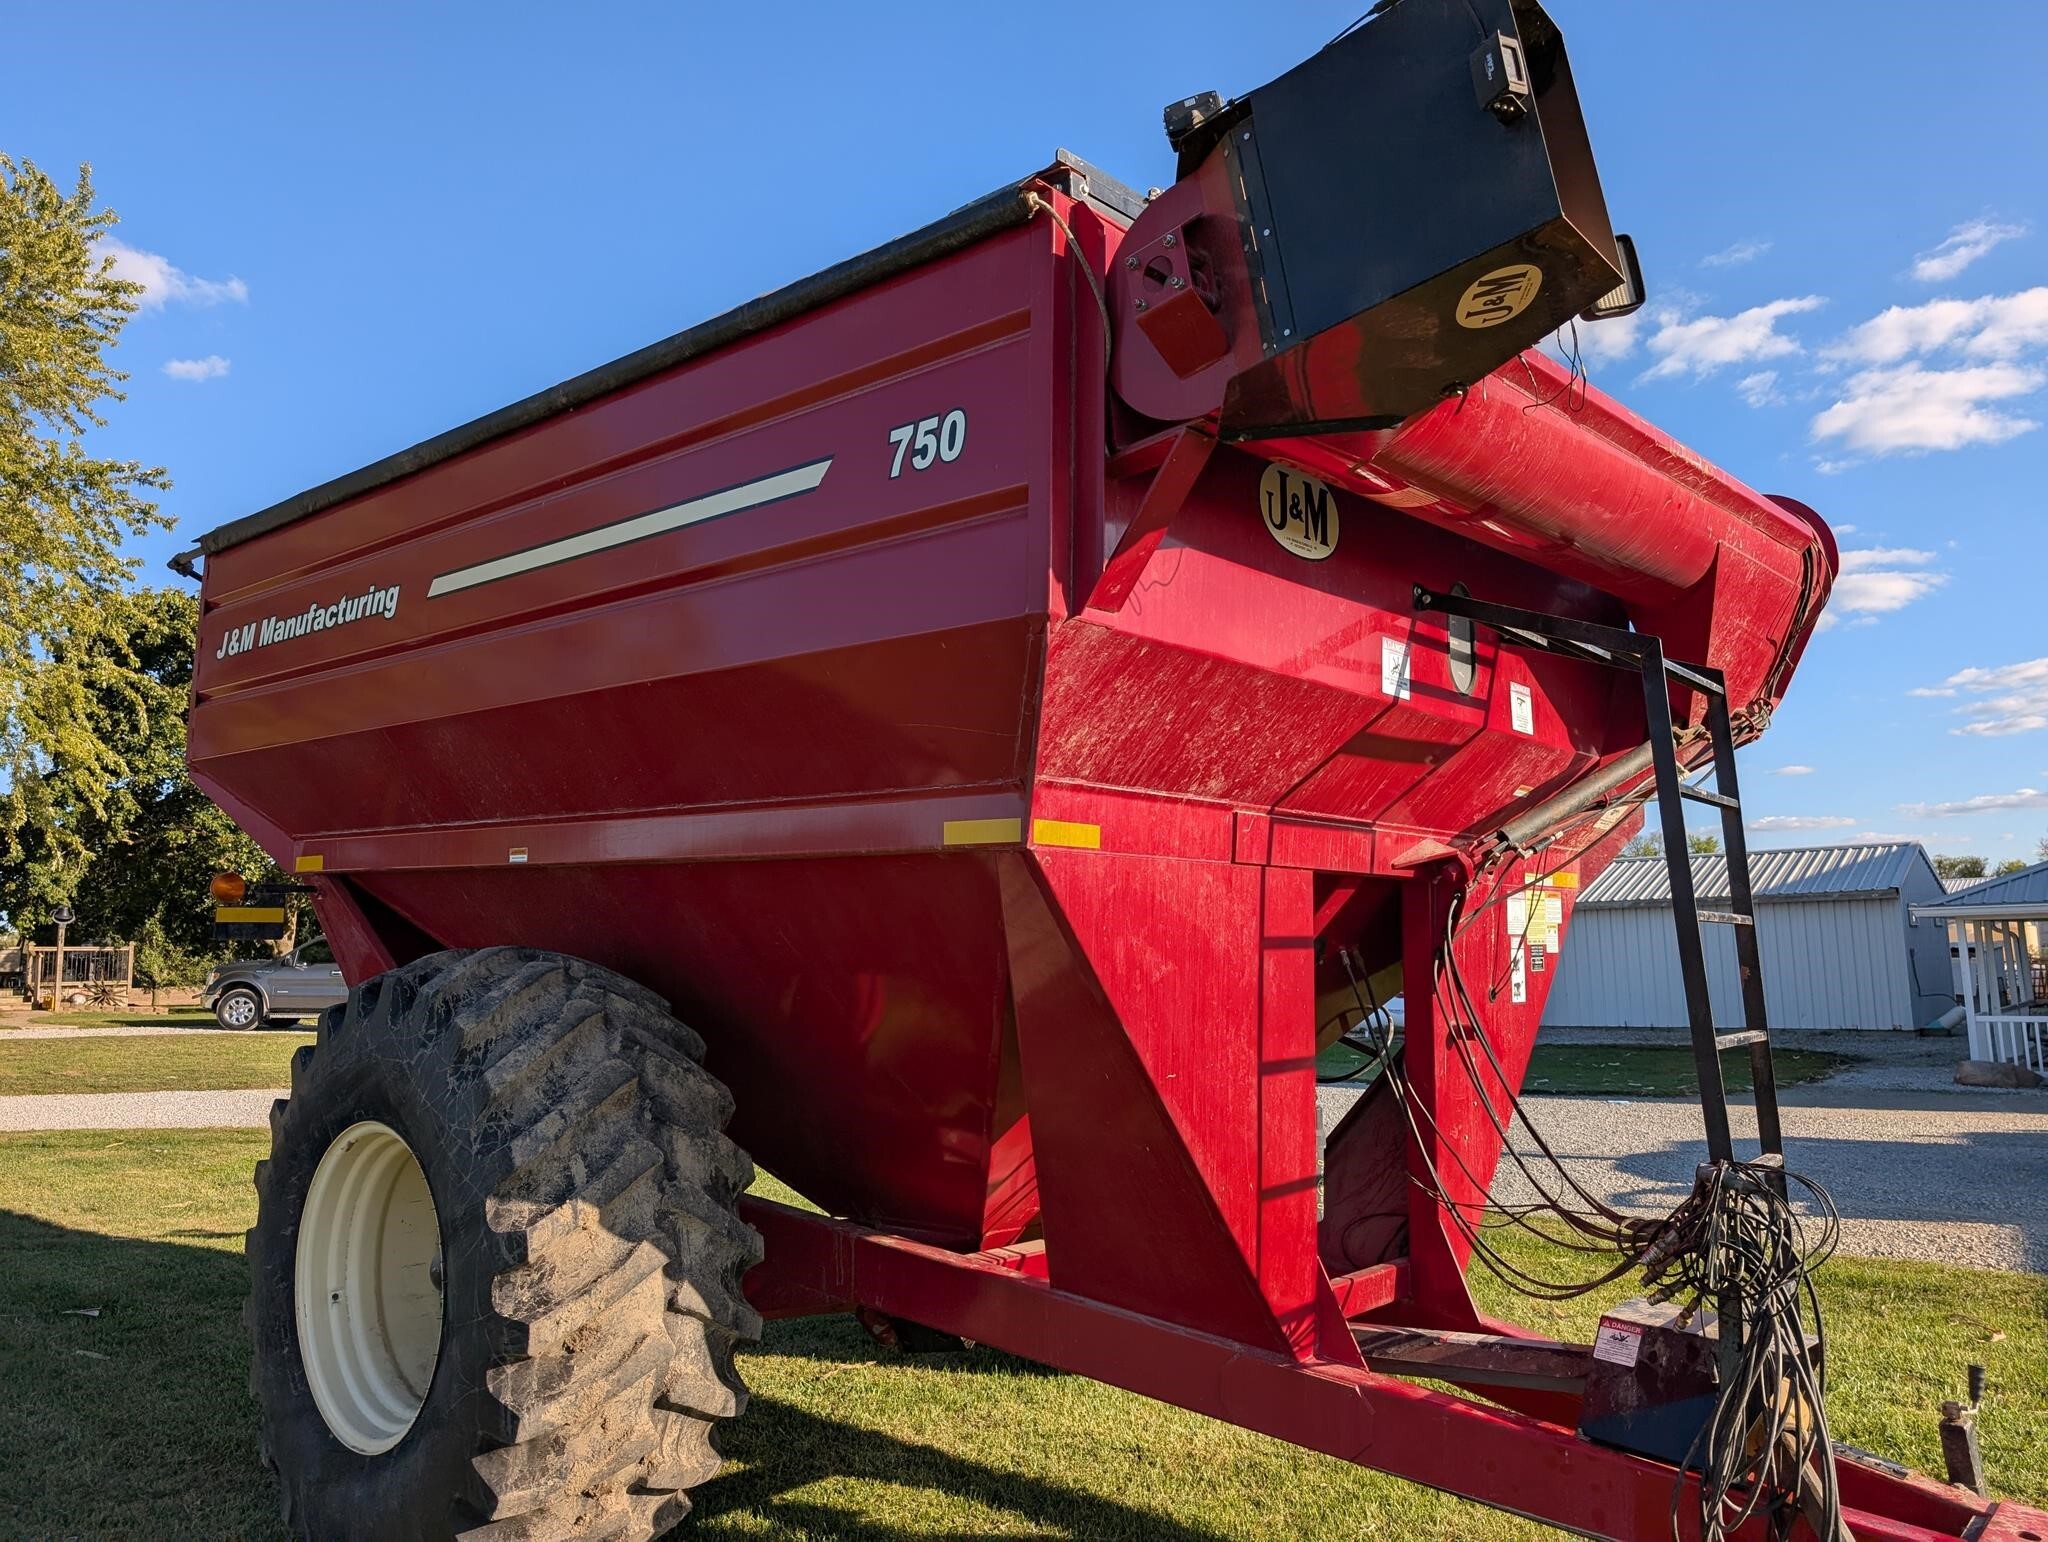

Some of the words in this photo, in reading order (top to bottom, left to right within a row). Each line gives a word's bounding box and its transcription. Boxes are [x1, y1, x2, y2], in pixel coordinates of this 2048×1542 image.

[1465, 269, 1529, 324] J&M
[888, 407, 967, 479] 750
[1266, 469, 1330, 547] J&M
[216, 622, 257, 660] J&M
[258, 584, 400, 648] Manufacturing
[1610, 1322, 1642, 1335] DANGER
